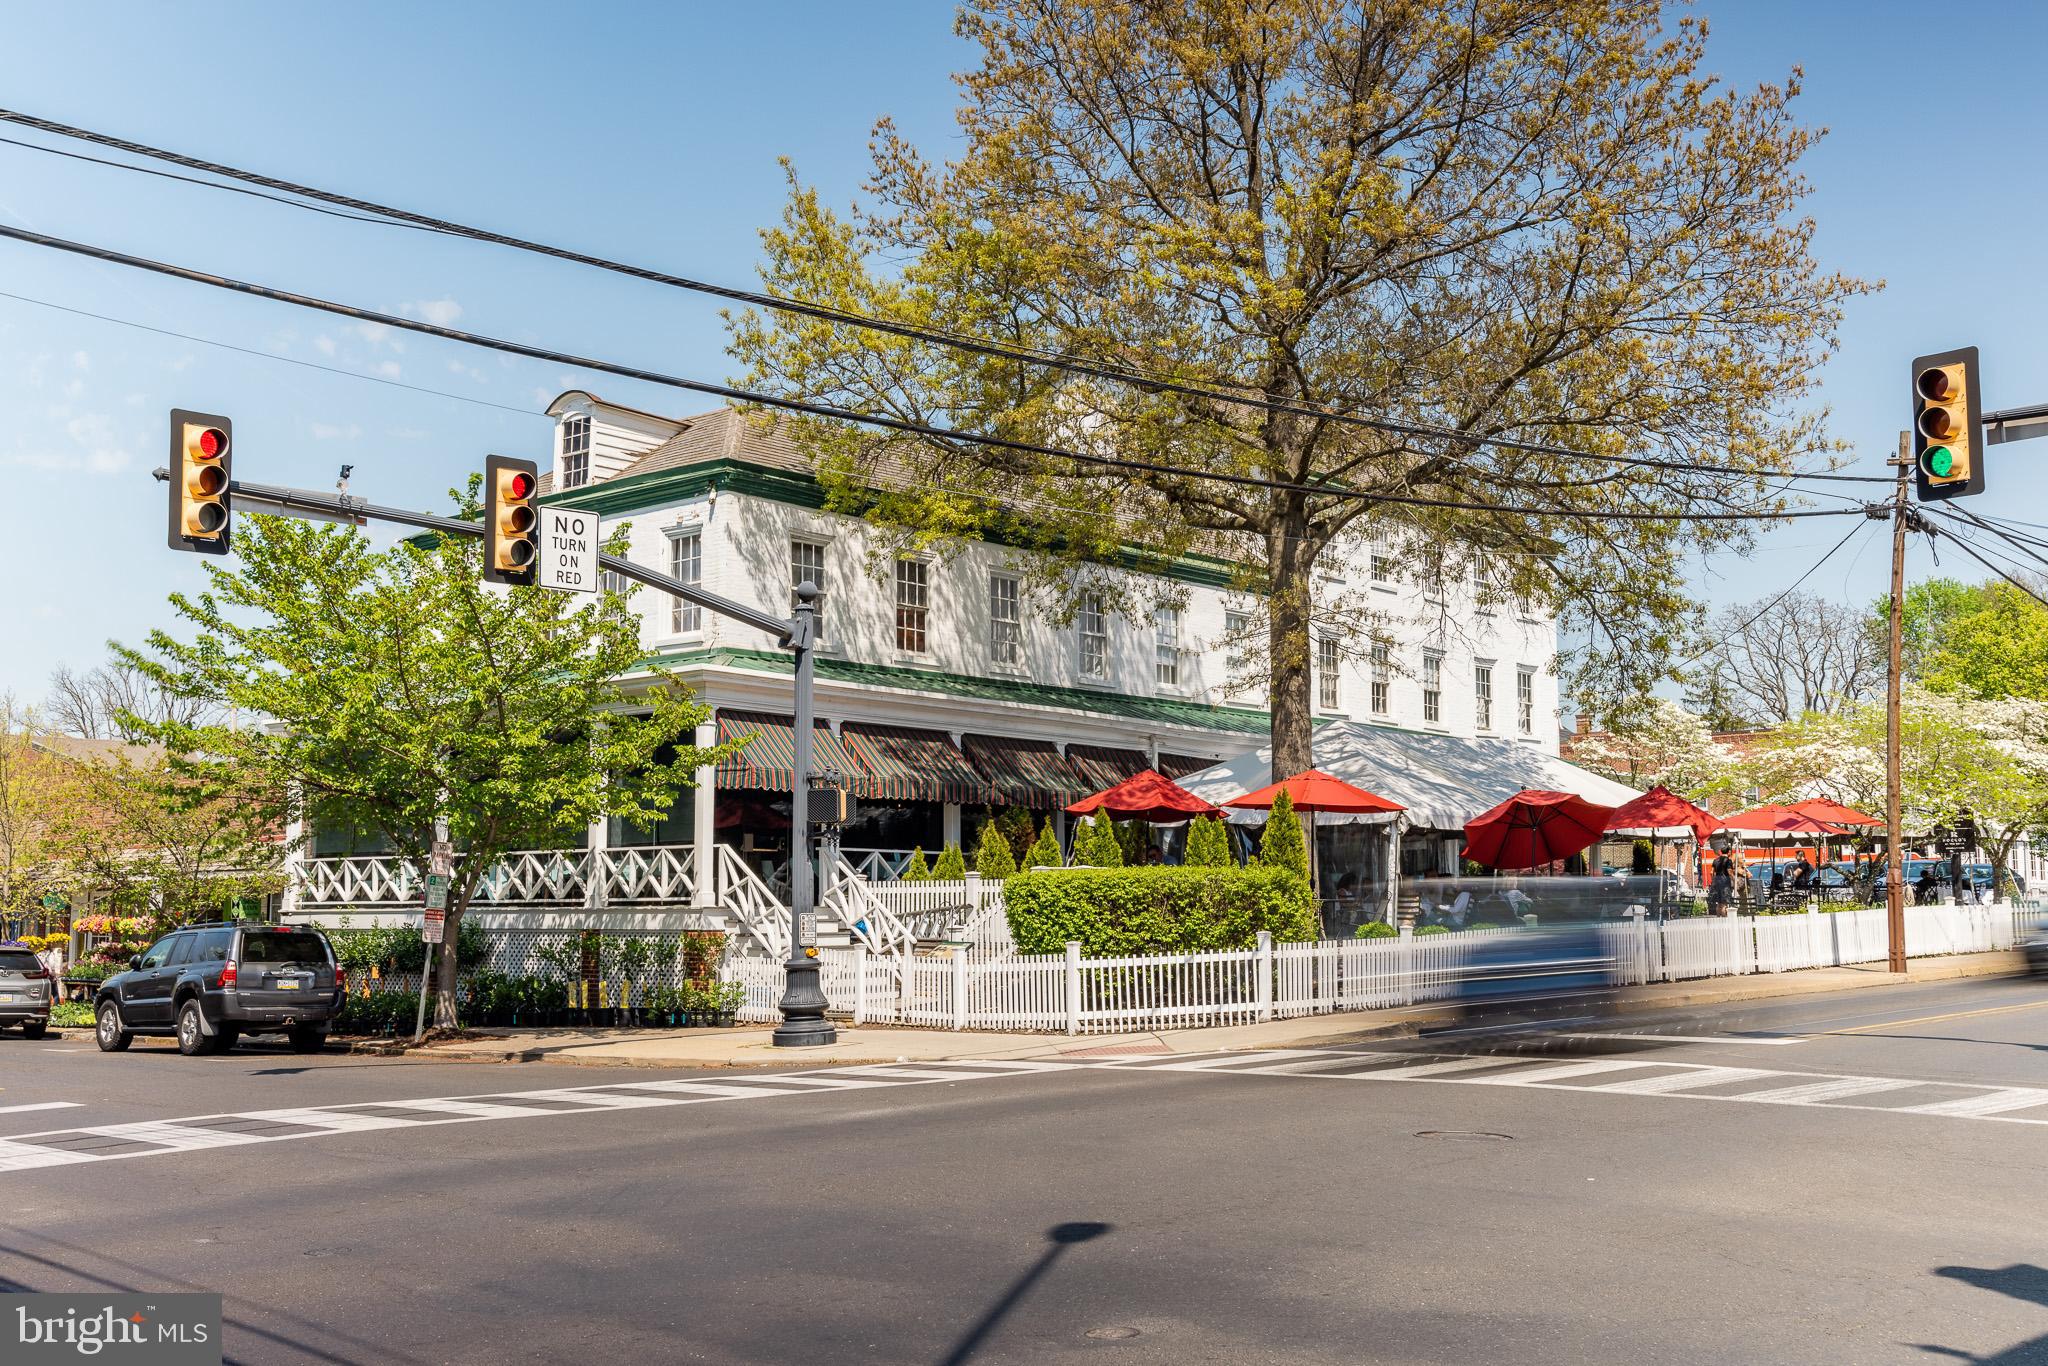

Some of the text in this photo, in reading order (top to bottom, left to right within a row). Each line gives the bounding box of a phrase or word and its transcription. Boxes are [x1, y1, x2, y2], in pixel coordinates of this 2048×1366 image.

[555, 516, 584, 535] NO
[552, 536, 586, 552] TURN
[560, 554, 578, 568] ON
[556, 570, 581, 584] RED
